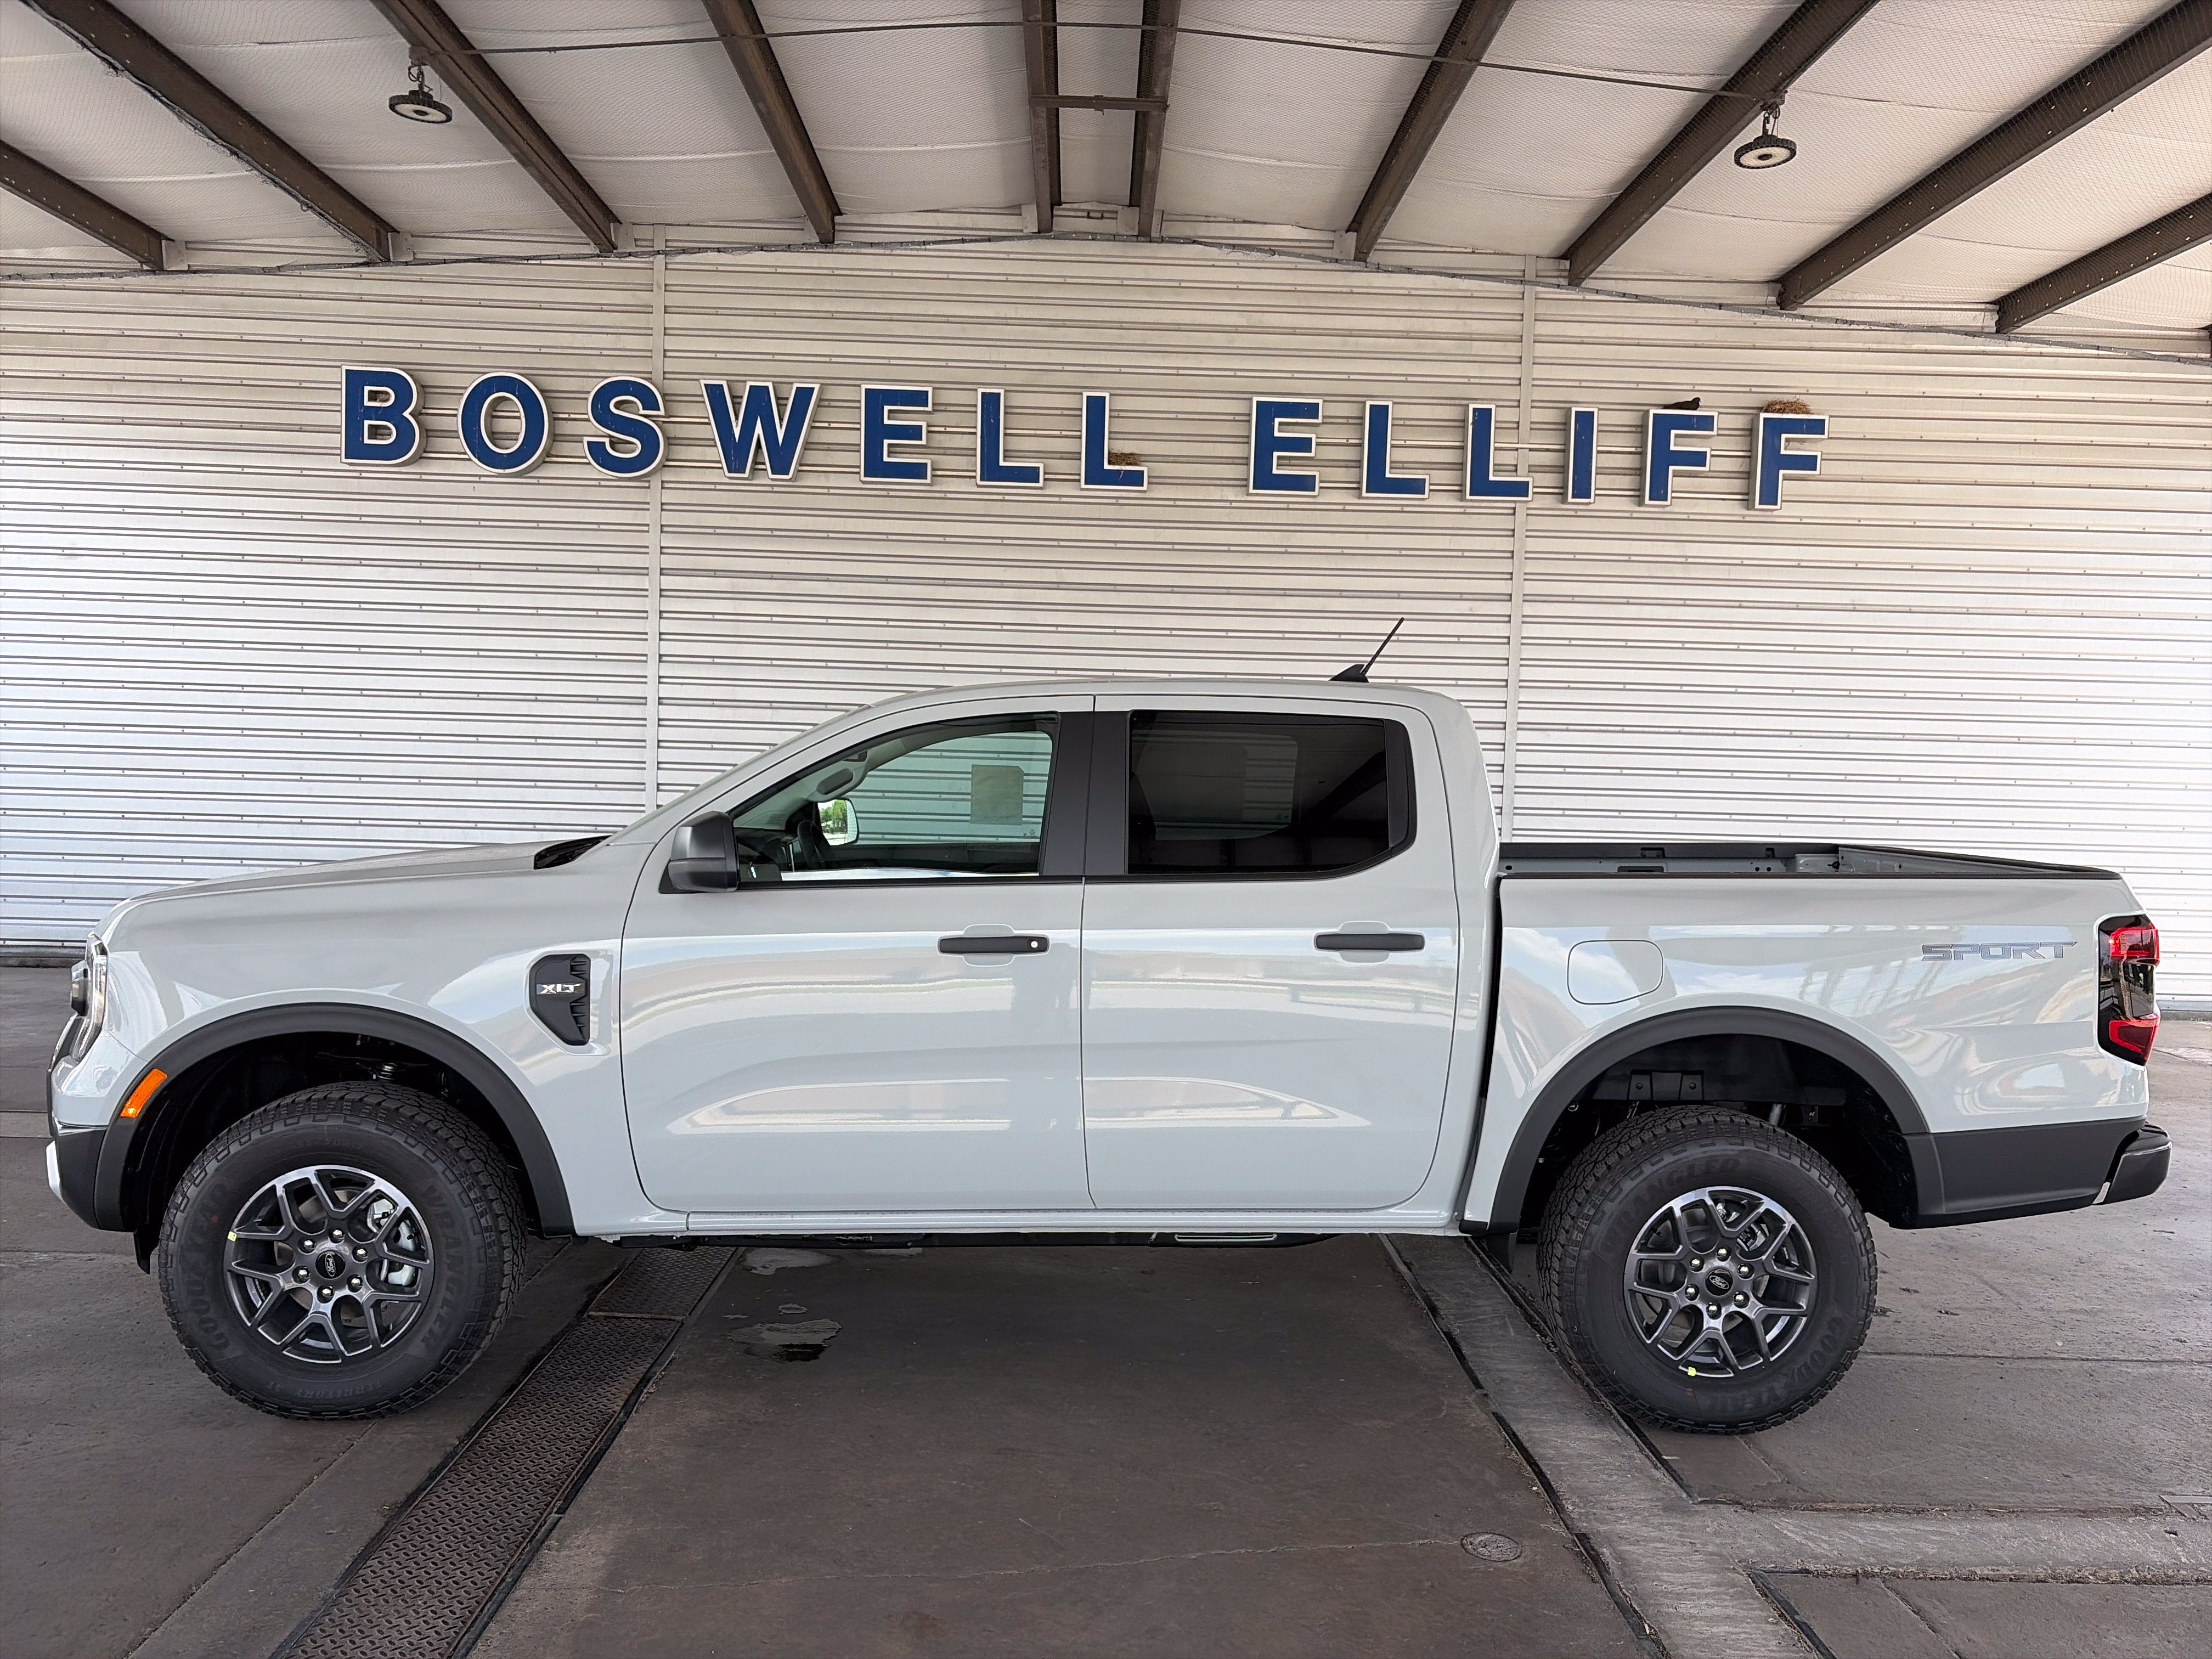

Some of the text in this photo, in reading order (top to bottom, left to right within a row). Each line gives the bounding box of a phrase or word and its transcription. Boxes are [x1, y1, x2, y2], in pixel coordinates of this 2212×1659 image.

[341, 364, 1829, 511] BOSWELL ELLIFF
[1921, 941, 2078, 961] SPORT
[540, 983, 582, 995] XLT
[1606, 1158, 1741, 1250] WRANGLER
[186, 1183, 230, 1350] GOODYEAR
[326, 1256, 335, 1274] Ford
[421, 1184, 465, 1350] WRANGLER
[1711, 1277, 1728, 1288] Ford
